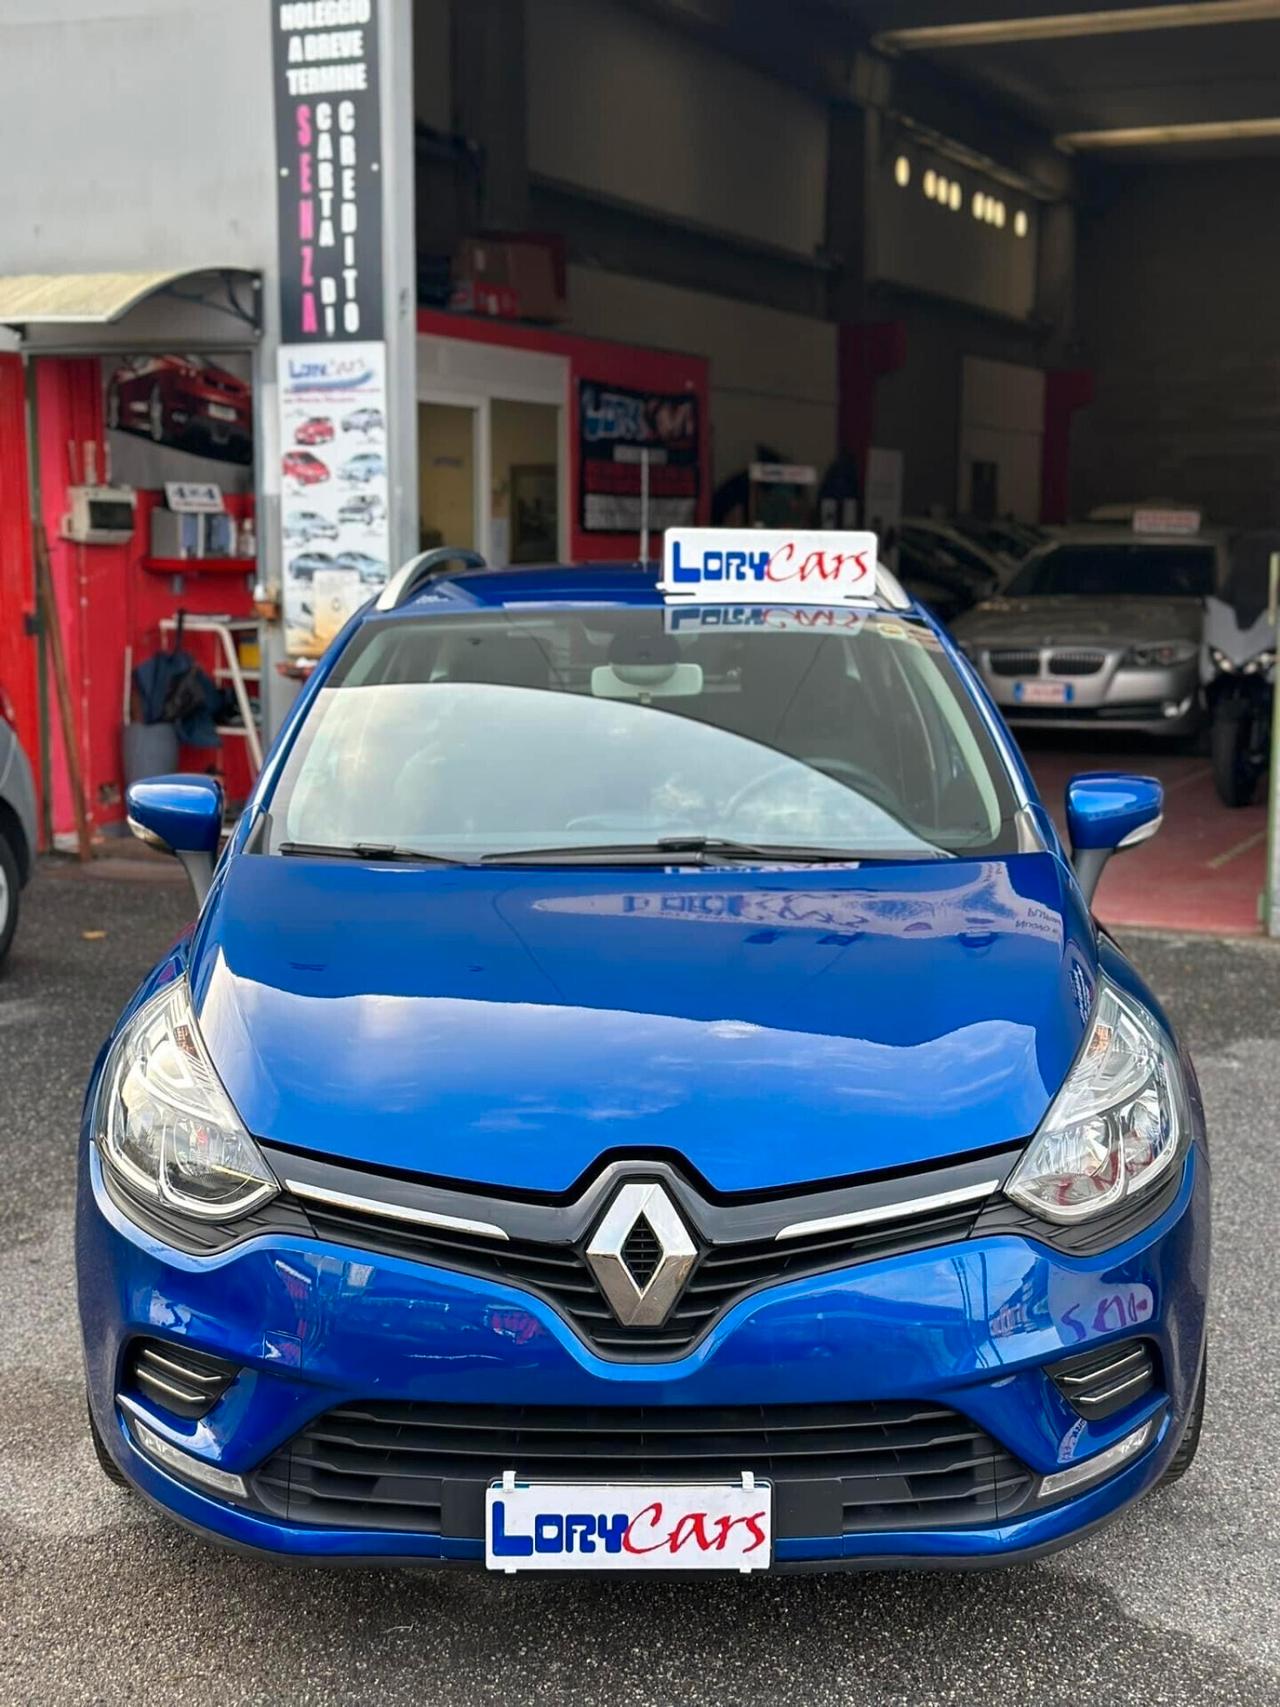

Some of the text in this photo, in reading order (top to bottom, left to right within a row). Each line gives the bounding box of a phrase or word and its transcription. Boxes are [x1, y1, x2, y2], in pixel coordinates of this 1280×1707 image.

[280, 0, 370, 30] NOLEGGIO
[286, 62, 367, 95] TERMINE
[288, 30, 363, 63] A BREVE
[296, 104, 317, 333] SENZA
[316, 102, 337, 335] CARTA DI
[338, 100, 360, 333] CREDITO
